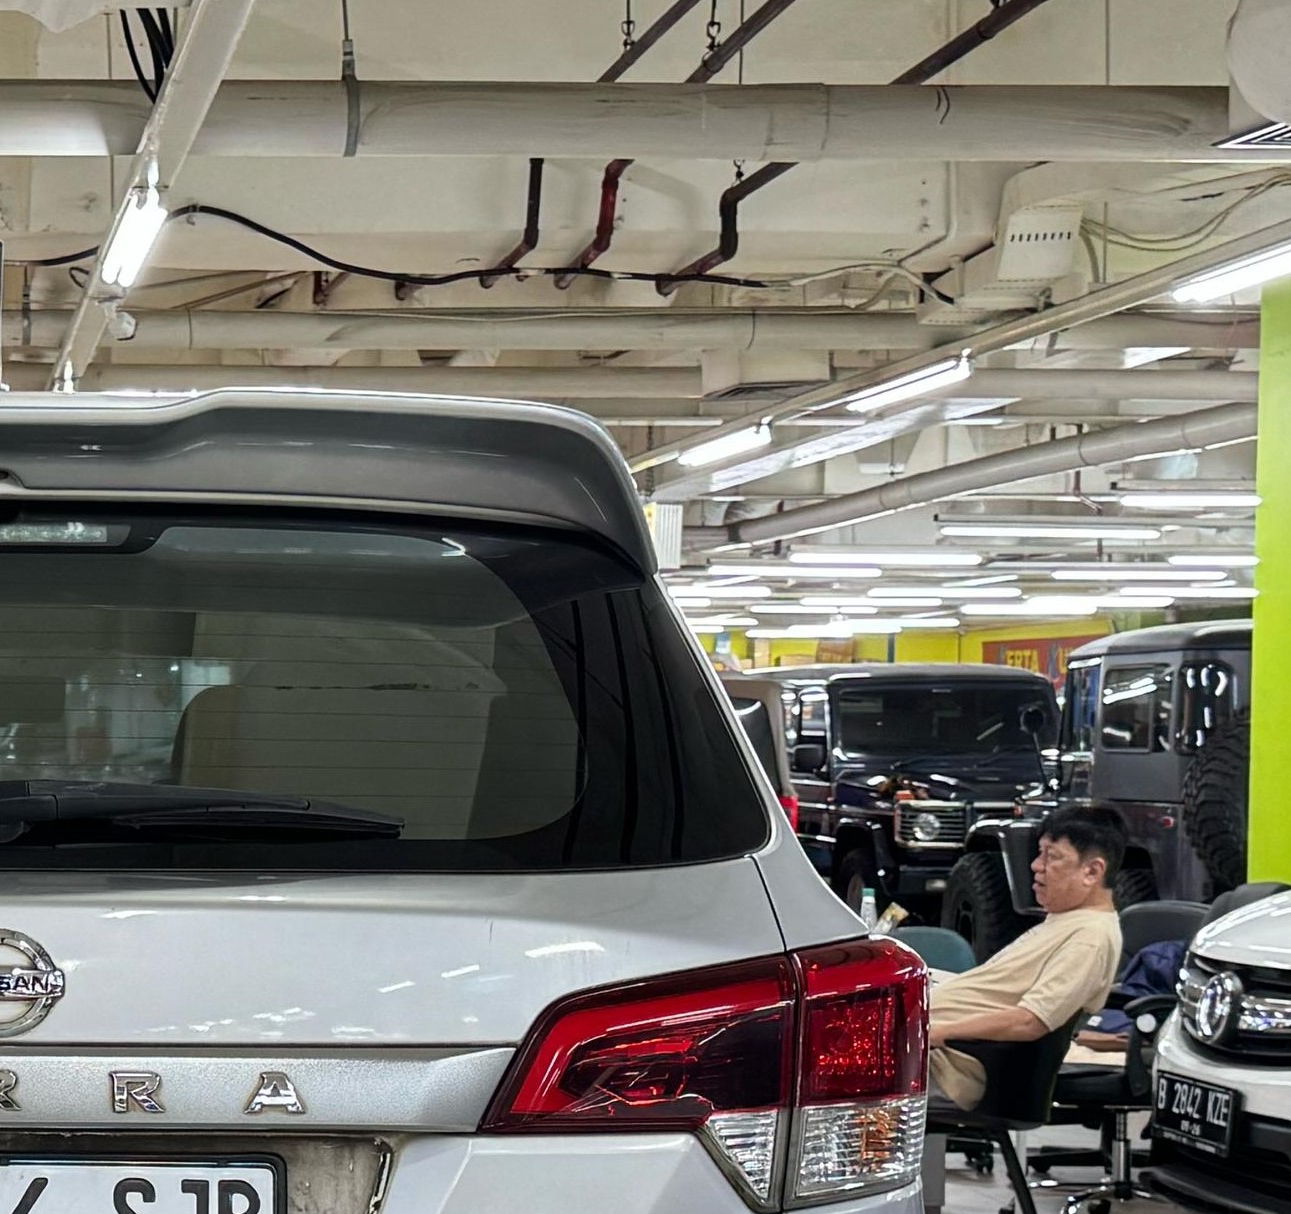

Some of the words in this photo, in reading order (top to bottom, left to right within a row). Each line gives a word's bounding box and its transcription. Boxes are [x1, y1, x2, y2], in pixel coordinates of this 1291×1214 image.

[1157, 1077, 1168, 1110] B
[1171, 1081, 1202, 1119] 2842
[1206, 1090, 1230, 1127] KZE
